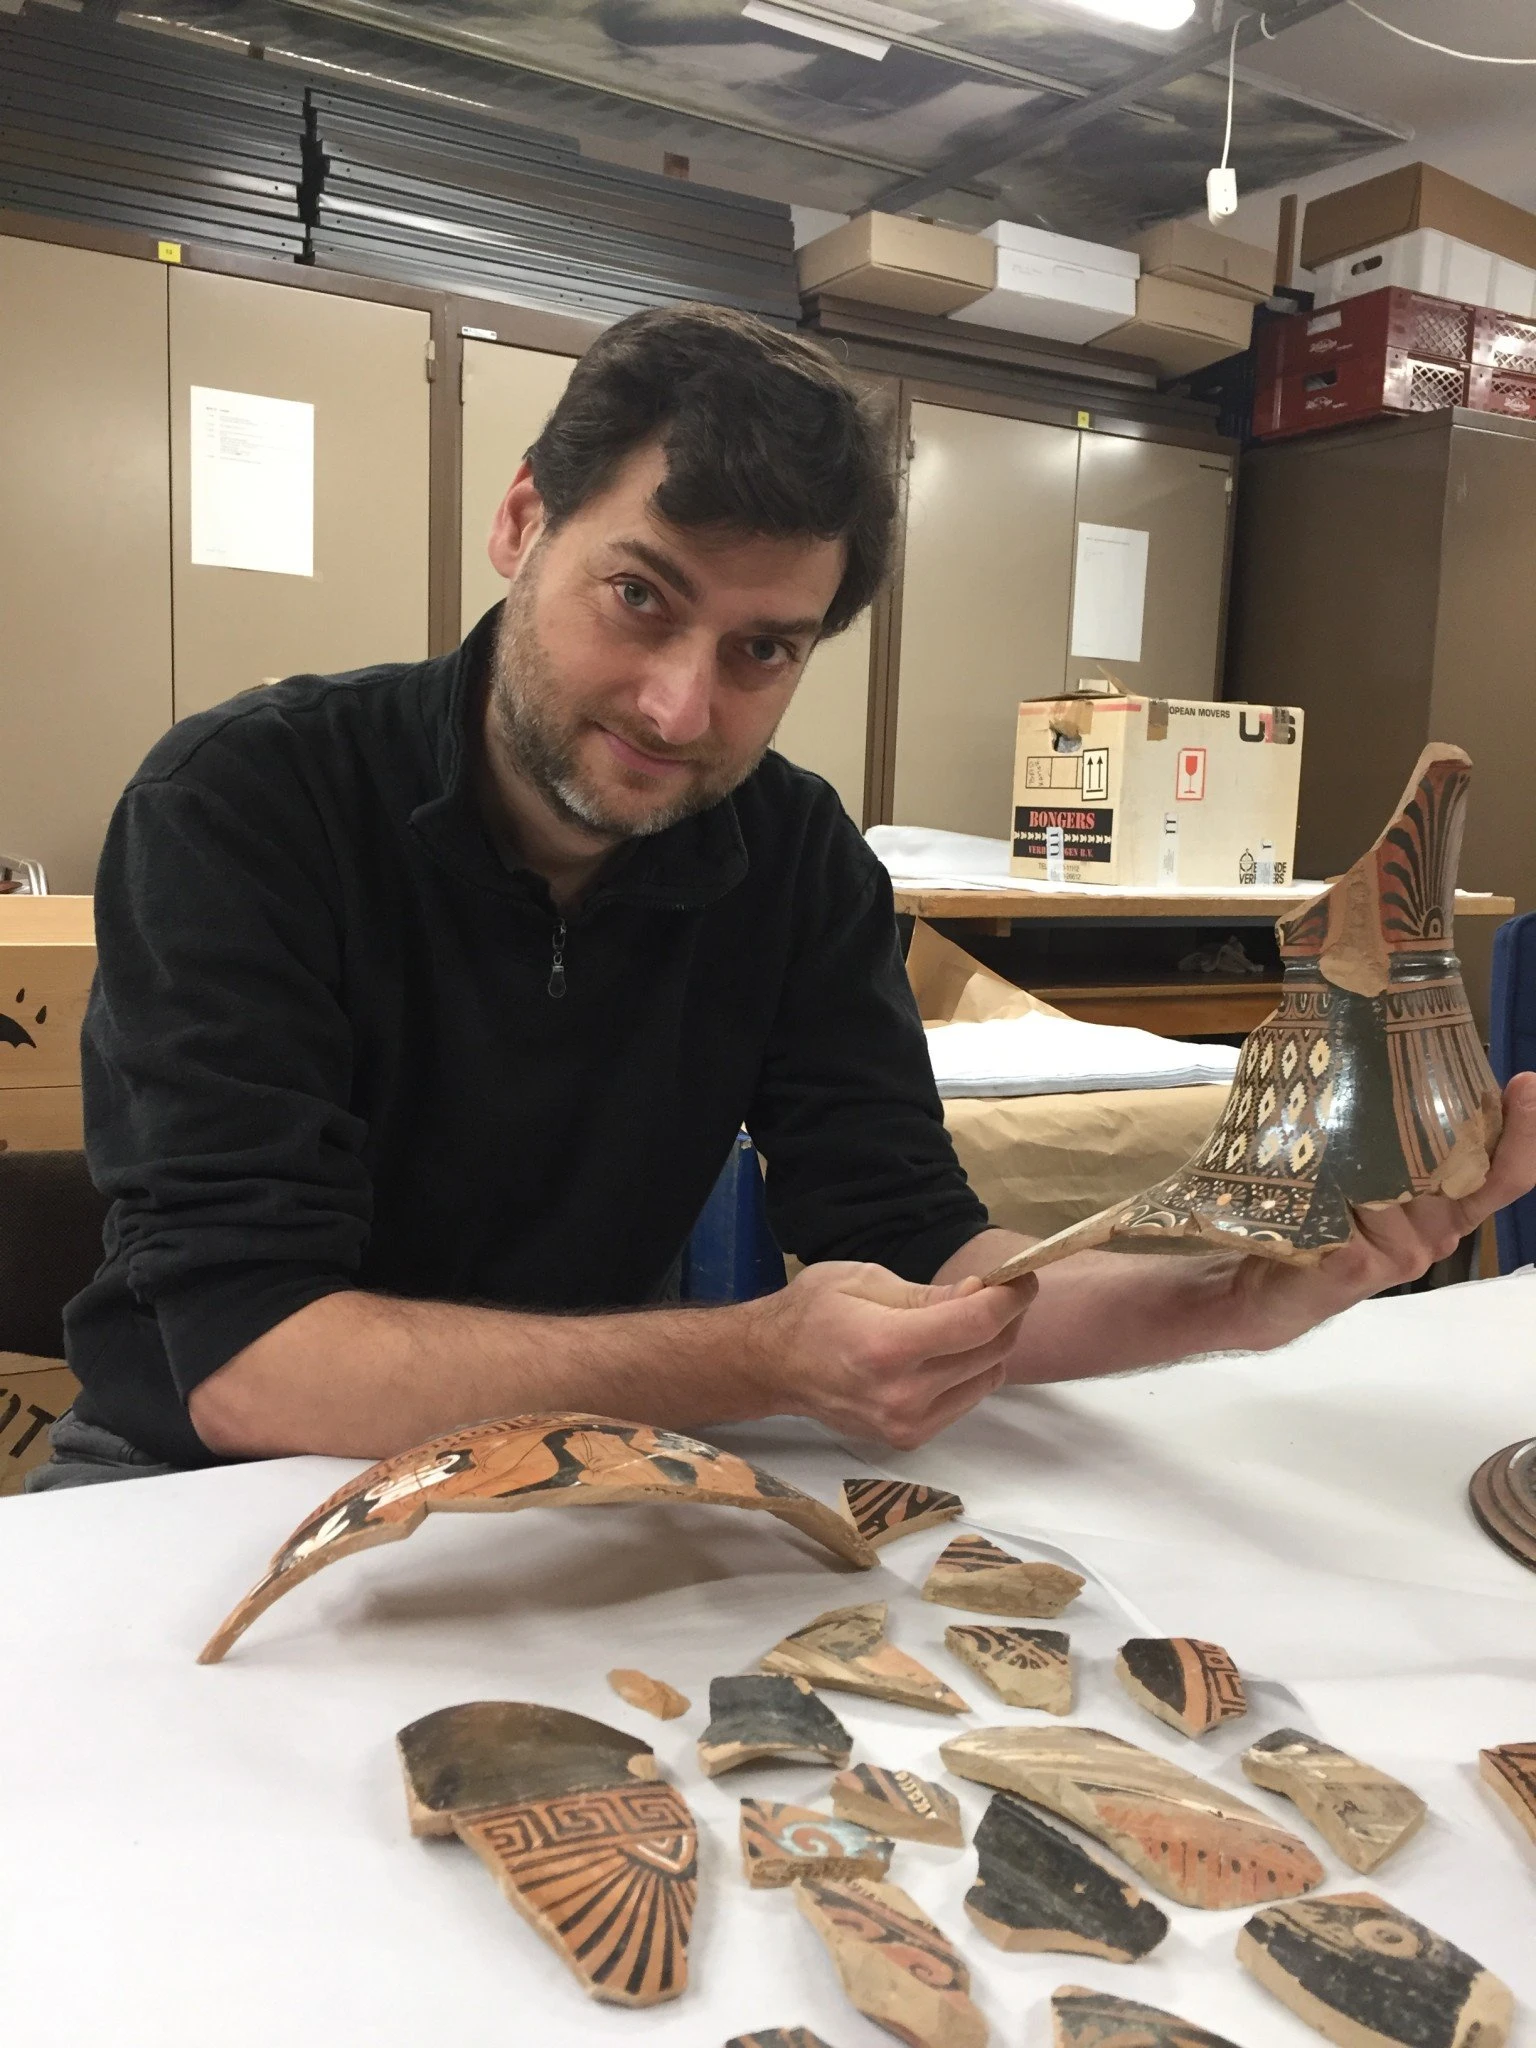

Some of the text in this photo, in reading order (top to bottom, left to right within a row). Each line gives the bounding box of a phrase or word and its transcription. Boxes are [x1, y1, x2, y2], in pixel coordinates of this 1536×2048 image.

[1169, 706, 1231, 719] OPEAN MOVERS
[1029, 811, 1095, 829] BONGERS
